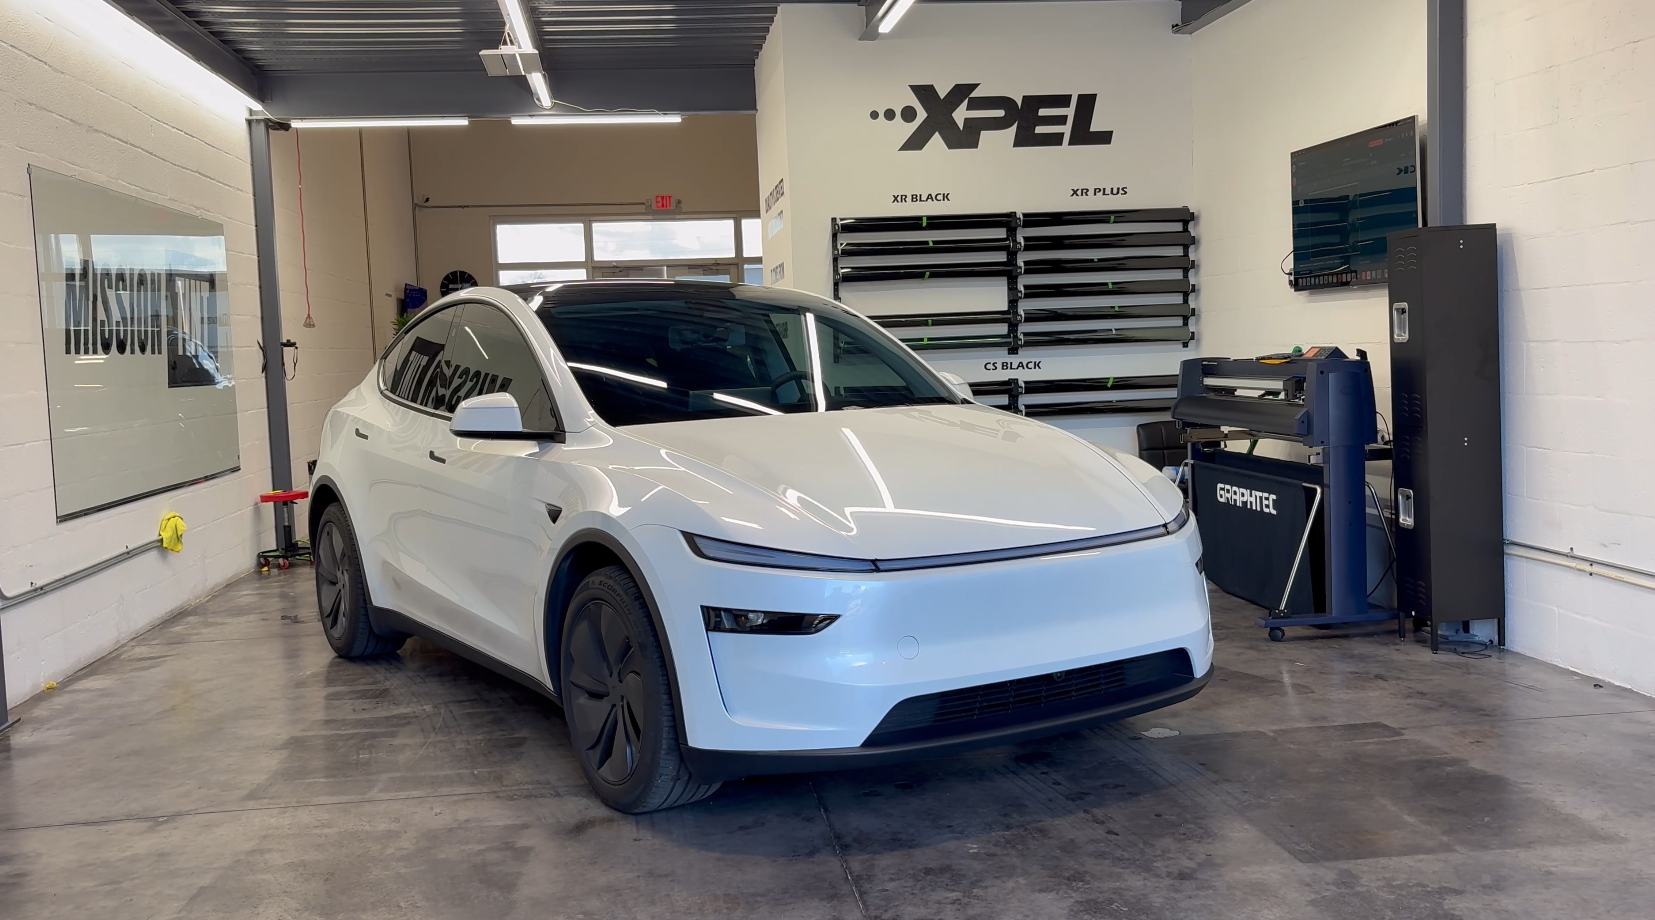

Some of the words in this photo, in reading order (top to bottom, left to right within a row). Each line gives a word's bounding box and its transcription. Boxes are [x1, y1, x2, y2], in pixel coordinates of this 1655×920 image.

[898, 83, 1114, 152] XPEL
[655, 195, 673, 209] EXIT
[891, 194, 908, 204] XR
[911, 192, 951, 203] BLACK
[1070, 188, 1090, 198] XR
[1093, 186, 1128, 197] PLUS
[65, 257, 163, 355] MISSION
[984, 361, 998, 371] CS
[1001, 360, 1042, 371] BLACK
[1216, 482, 1277, 515] GRAPHTEC
[598, 580, 633, 616] SCORPION
